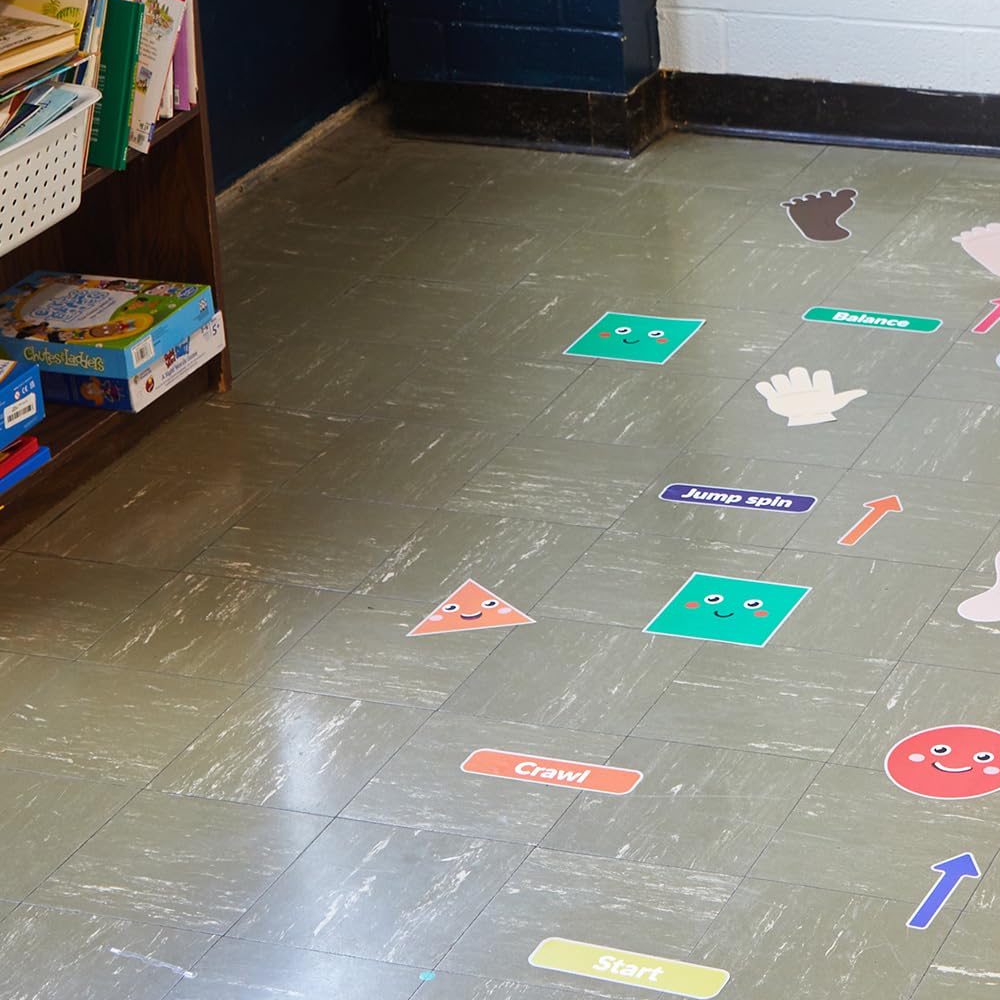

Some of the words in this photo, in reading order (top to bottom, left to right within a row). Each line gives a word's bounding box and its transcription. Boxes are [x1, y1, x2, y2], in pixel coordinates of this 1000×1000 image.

[831, 311, 911, 328] Balance
[681, 488, 743, 505] Jump
[744, 495, 793, 509] spin
[514, 761, 592, 783] Crawl
[591, 955, 664, 982] Start
